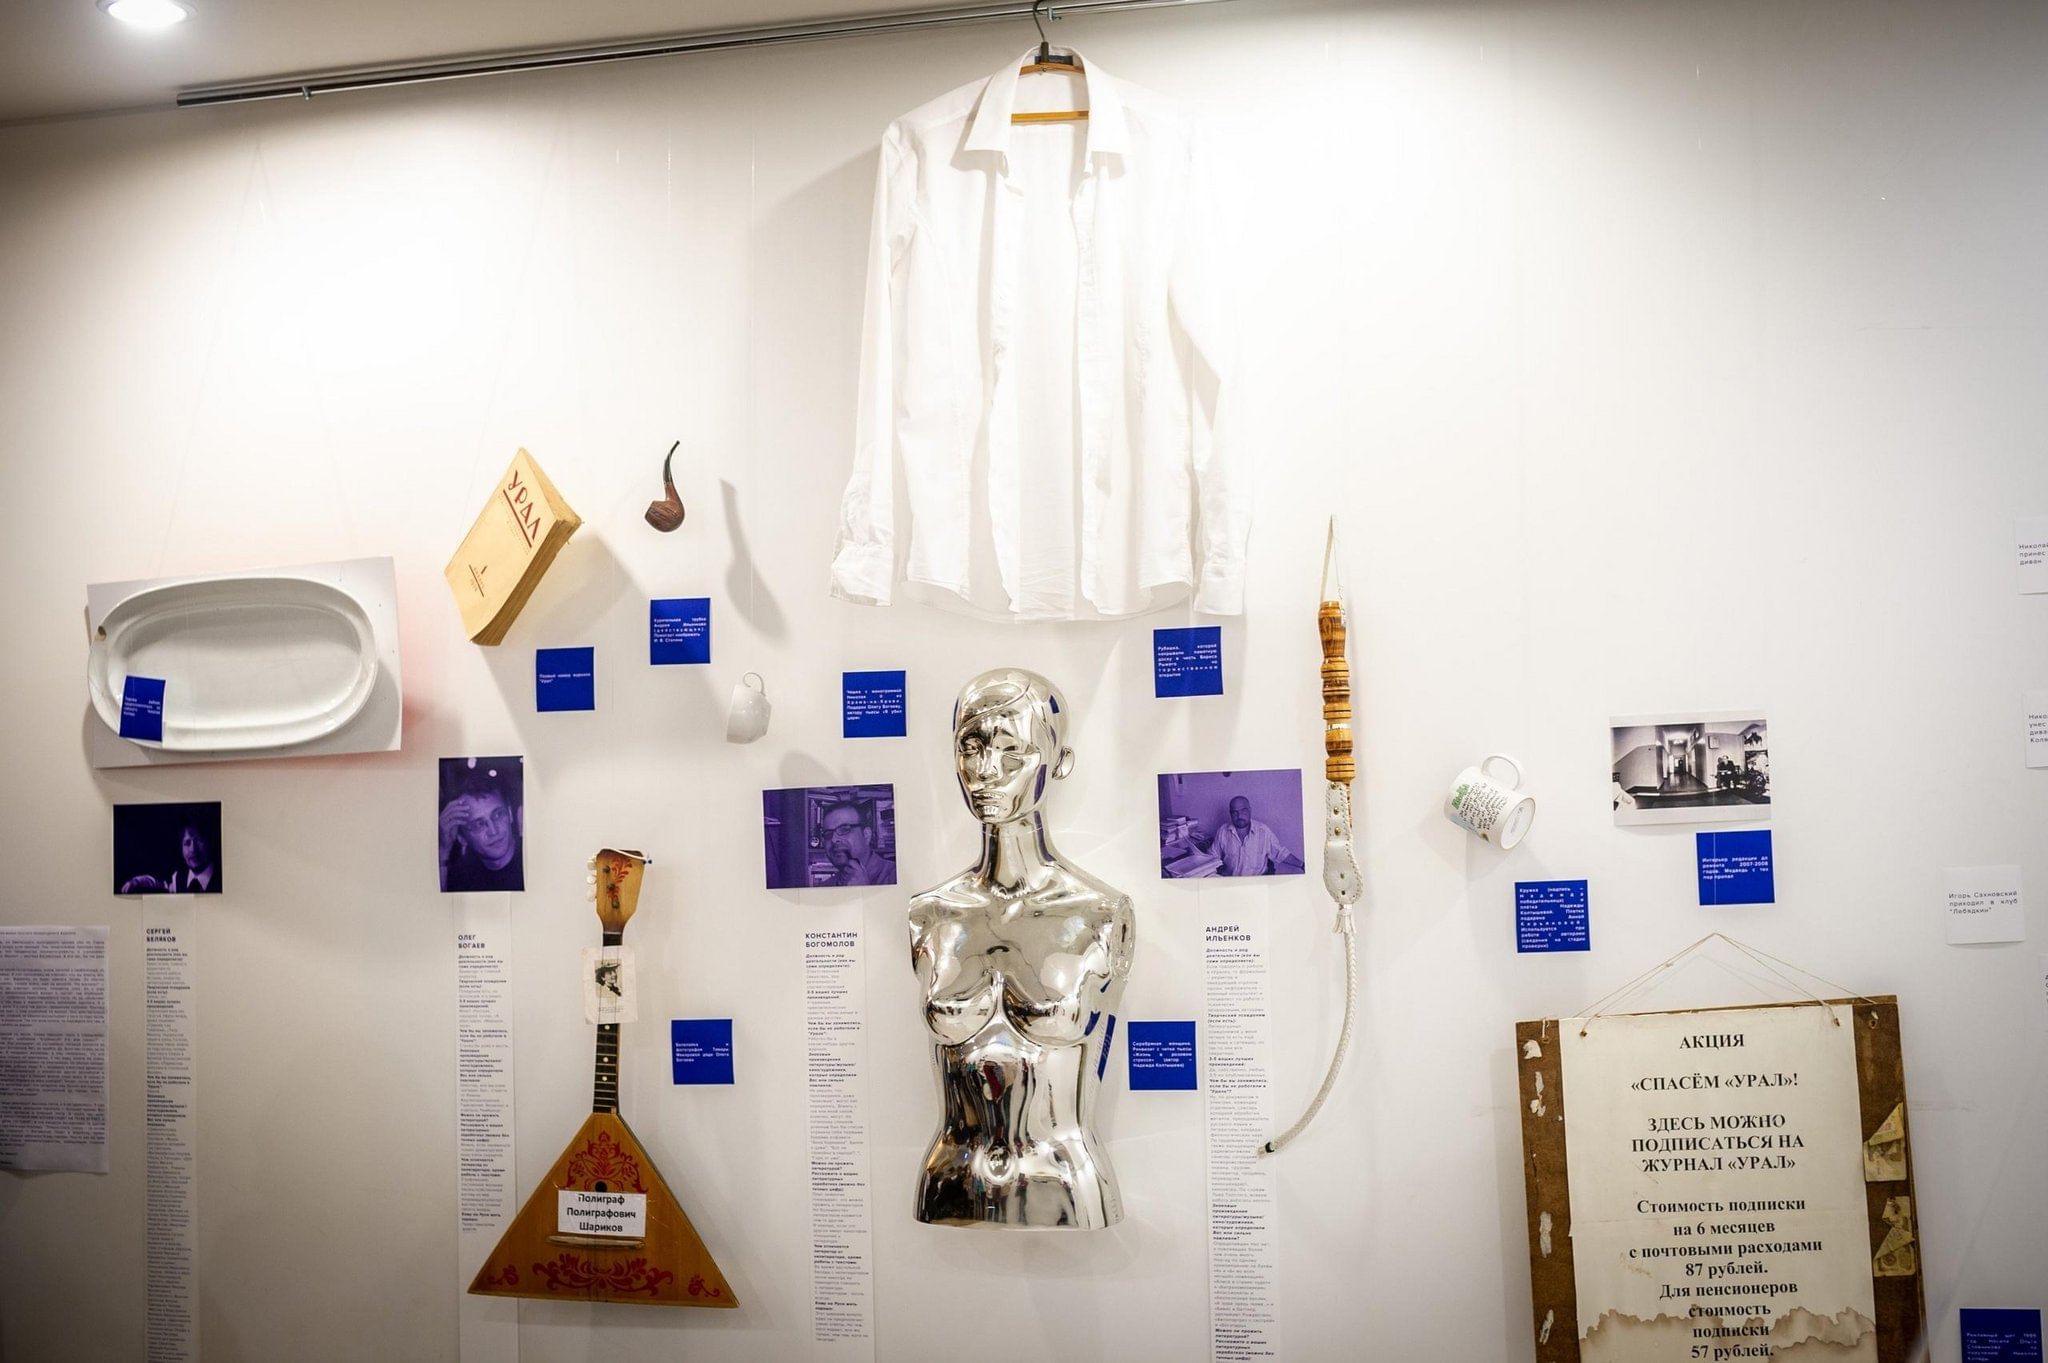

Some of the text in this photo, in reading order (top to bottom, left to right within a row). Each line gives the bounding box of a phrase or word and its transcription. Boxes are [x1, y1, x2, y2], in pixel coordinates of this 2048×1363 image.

[508, 470, 541, 540] УРАЛ
[1679, 1034, 1744, 1049] АКЦИЯ
[1631, 1071, 1798, 1091] «СПАСЁМ «УРАЛ»!
[1648, 1114, 1786, 1132] ЗДЕСЬ МОЖНО
[1632, 1134, 1804, 1153] ПОДПИСАТЬСЯ НА
[1642, 1155, 1796, 1172] ЖУРНАЛ «УРАЛ»
[578, 1194, 625, 1205] Полиграф
[1636, 1199, 1806, 1214] Стоимость подписки
[566, 1208, 636, 1218] Полиграфович
[580, 1222, 623, 1232] Шариков
[1673, 1222, 1776, 1236] на 6 месяцев
[1629, 1240, 1823, 1259] с почтовыми расходами
[1685, 1260, 1768, 1278] 87 рублей.
[1659, 1283, 1799, 1300] Для пенсионеров
[1688, 1304, 1771, 1316] стоимость
[1693, 1325, 1770, 1340] подписки
[1691, 1343, 1774, 1360] 57 рублей.
